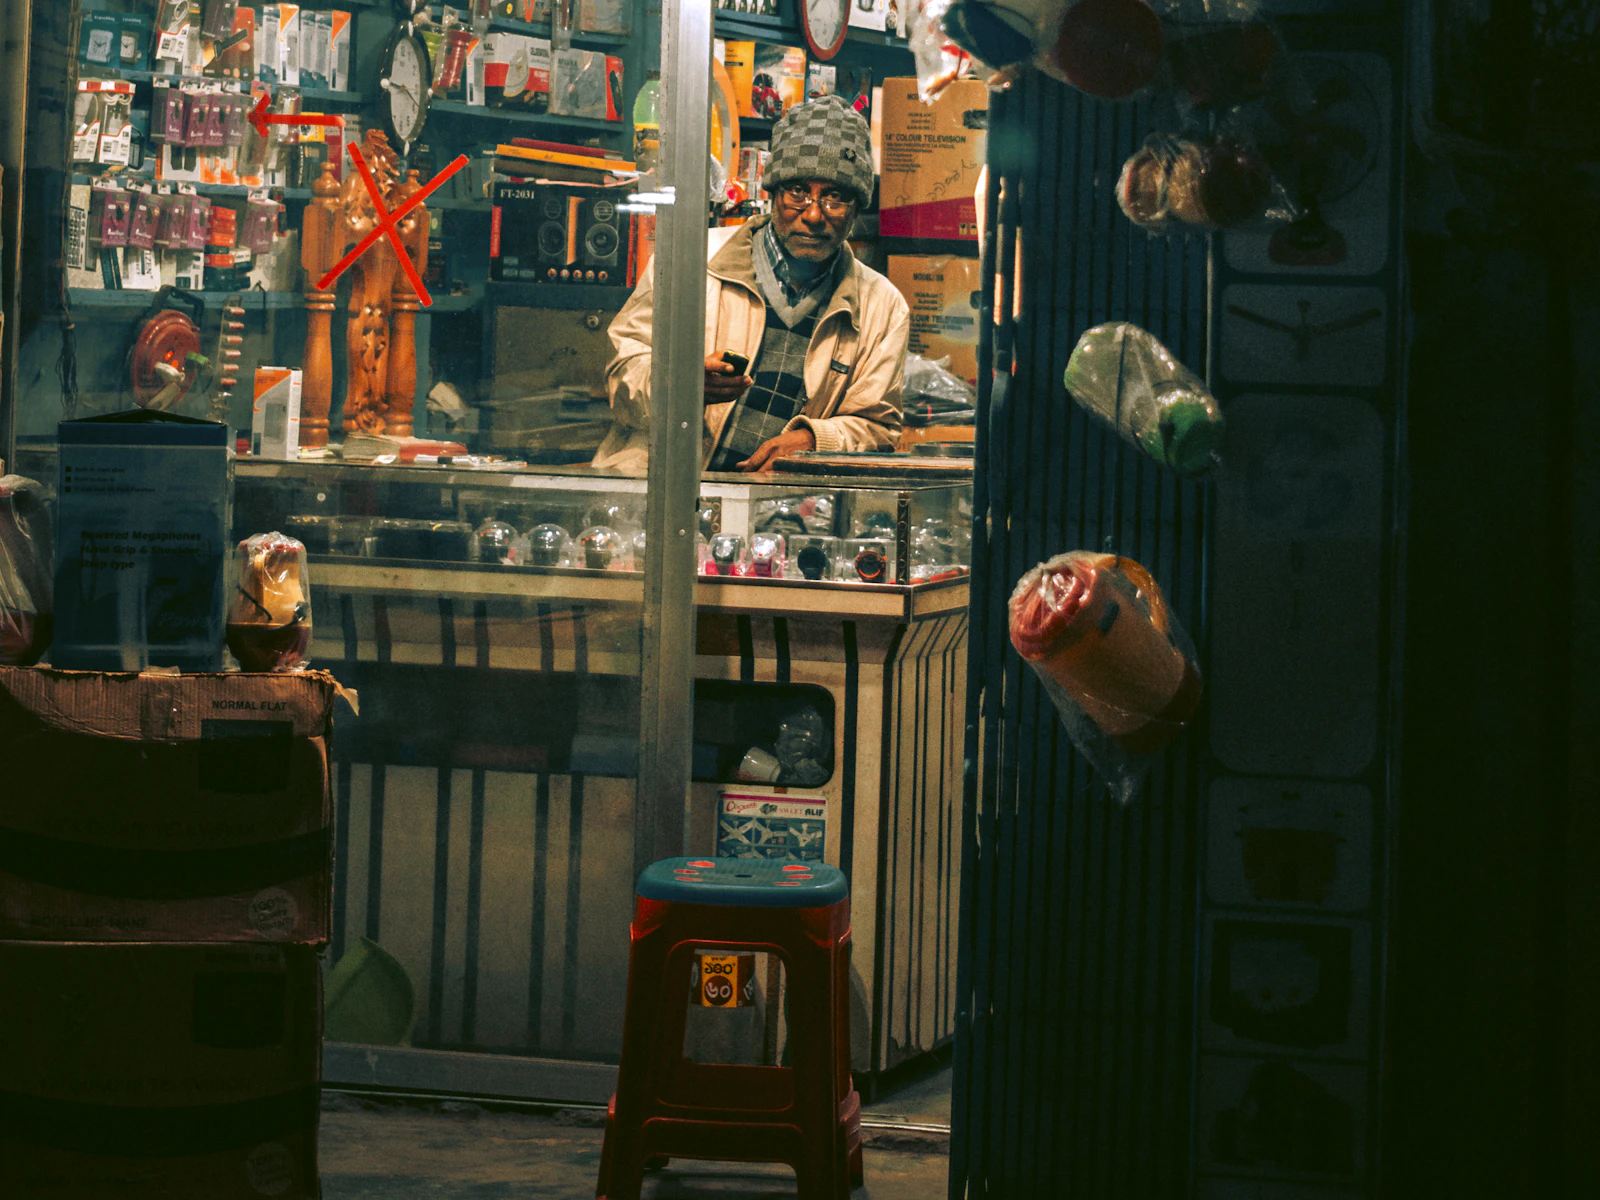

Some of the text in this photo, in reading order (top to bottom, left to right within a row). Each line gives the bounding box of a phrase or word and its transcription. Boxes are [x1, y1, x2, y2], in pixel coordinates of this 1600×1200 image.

[896, 133, 922, 143] COLOUR
[924, 134, 967, 144] TELEVISION
[500, 188, 535, 200] FT-2031
[80, 531, 202, 542] Powered Megaphones
[80, 545, 110, 554] Hand
[113, 545, 136, 555] Grip
[110, 560, 135, 570] type
[212, 700, 288, 712] NORMAL FLAT
[804, 808, 825, 817] ALIF
